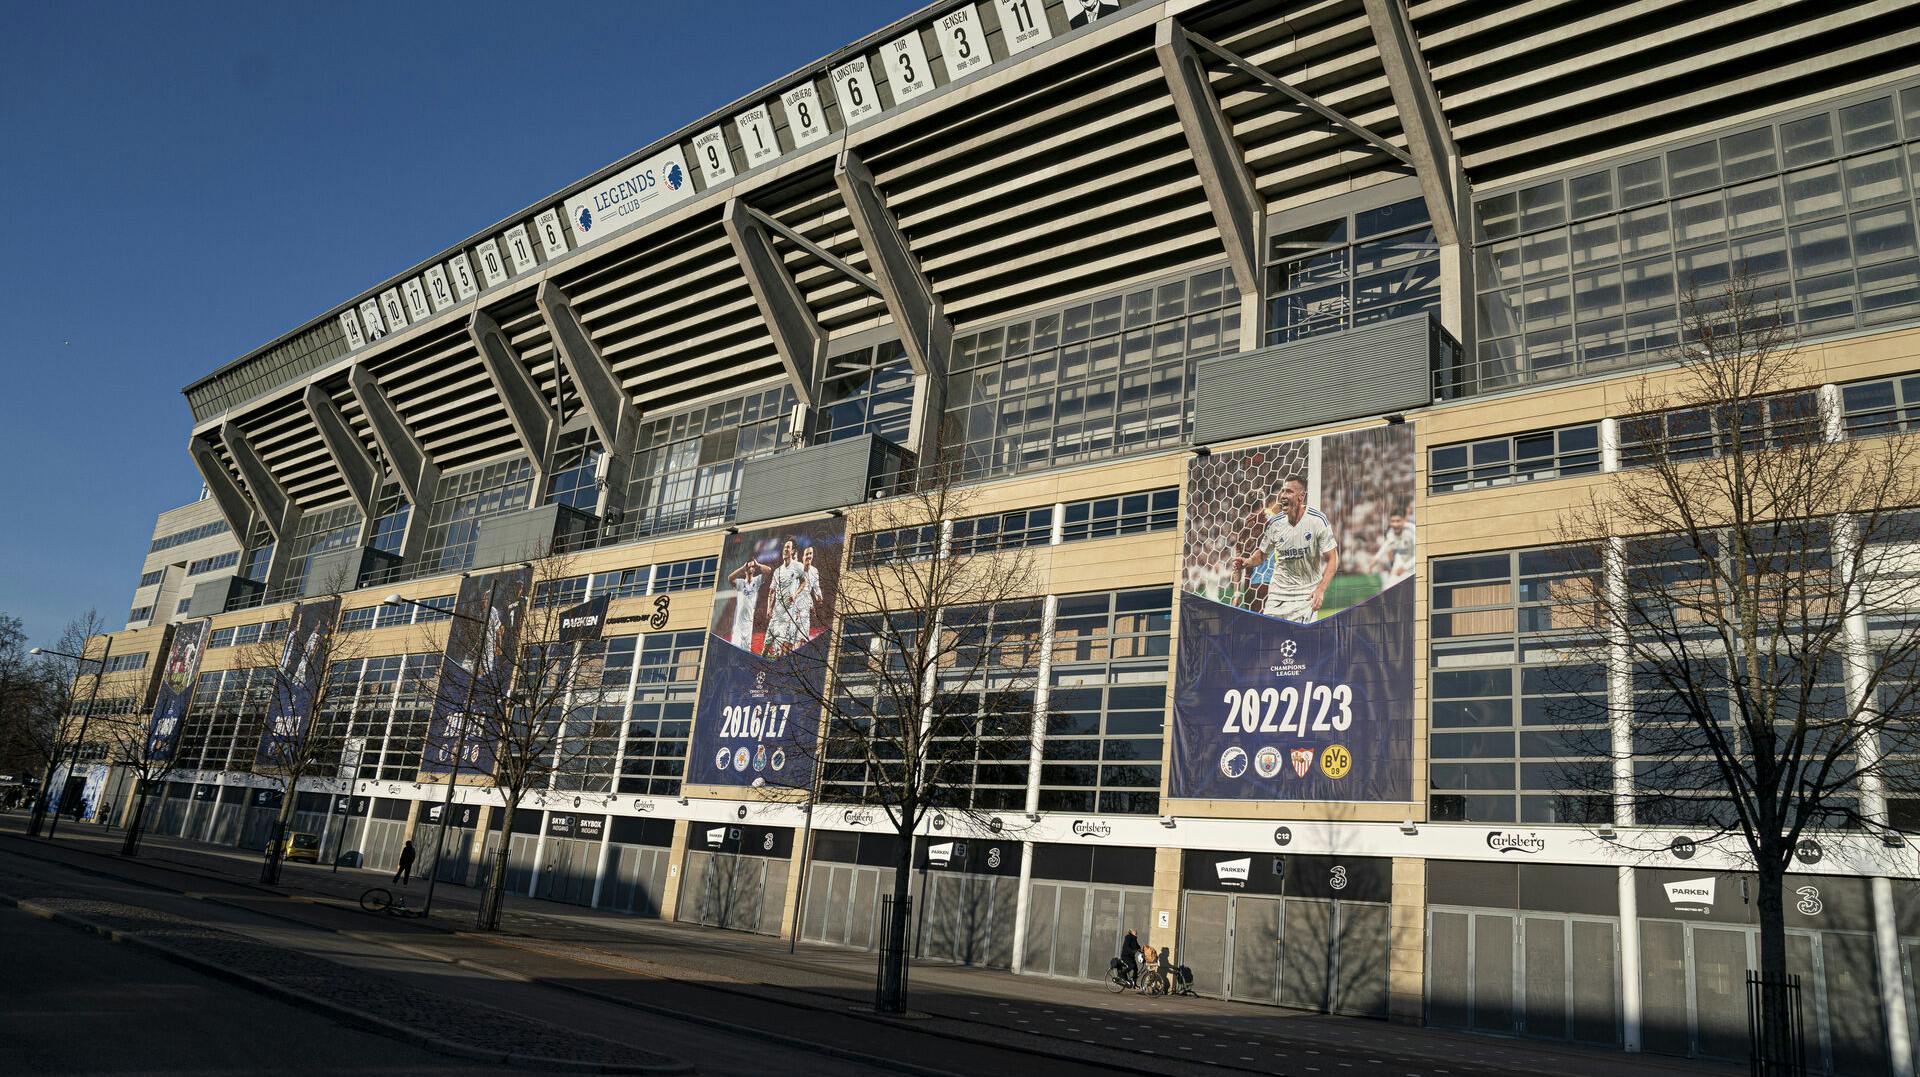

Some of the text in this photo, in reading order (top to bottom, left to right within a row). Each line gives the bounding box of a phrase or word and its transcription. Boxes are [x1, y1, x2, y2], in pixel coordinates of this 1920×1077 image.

[942, 11, 968, 31] JENSEN
[1011, 0, 1034, 32] 11
[894, 39, 908, 52] TUR
[953, 27, 971, 59] 3
[898, 53, 915, 83] 3
[847, 78, 863, 106] 6
[740, 110, 764, 128] PETERSEN
[797, 102, 812, 128] 8
[752, 123, 763, 148] 1
[707, 145, 719, 169] 9
[593, 169, 656, 212] LEGENDS
[618, 199, 641, 217] CLUB
[546, 224, 556, 245] 6
[515, 238, 527, 260] 11
[485, 252, 498, 274] 10
[458, 265, 469, 287] 5
[409, 289, 422, 311] 17
[433, 278, 446, 300] 12
[388, 301, 400, 321] 10
[346, 320, 358, 340] 14
[650, 595, 670, 630] 3
[1270, 664, 1306, 672] CHAMPIONS
[1222, 681, 1353, 738] 2022/23
[719, 701, 791, 742] 2016/17
[844, 810, 873, 826] Carlsberg
[1072, 819, 1111, 838] Carlsberg
[1276, 832, 1290, 840] C12
[1486, 831, 1545, 853] Carlsberg
[987, 847, 1001, 868] 3
[1329, 865, 1348, 890] 3
[1672, 888, 1709, 896] PARKEN
[1795, 886, 1823, 915] 3
